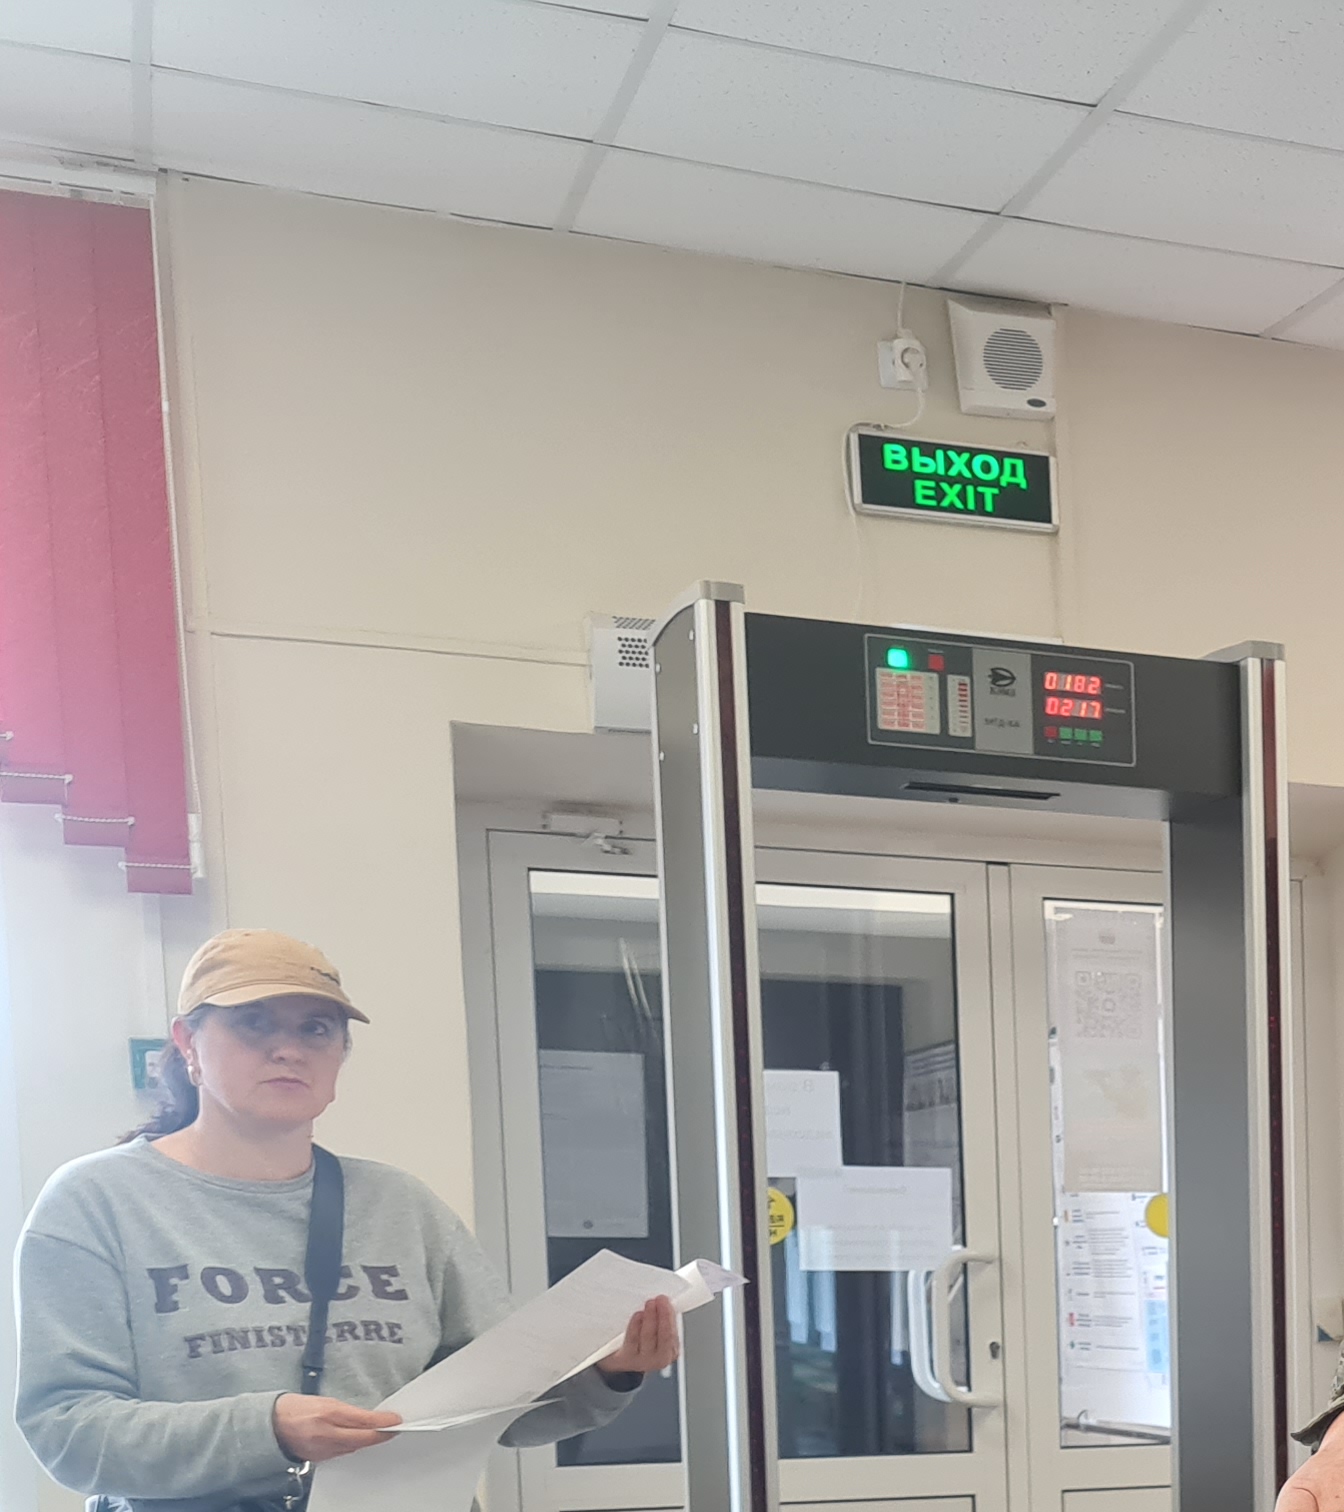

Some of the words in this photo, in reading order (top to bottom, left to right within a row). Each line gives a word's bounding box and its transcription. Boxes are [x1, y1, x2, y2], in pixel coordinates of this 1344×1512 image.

[882, 442, 1028, 490] ВЫХОД
[914, 479, 1000, 513] EXIT
[1044, 672, 1103, 694] 0182
[1045, 697, 1103, 719] 0217
[183, 1319, 404, 1359] FINISTRRE
